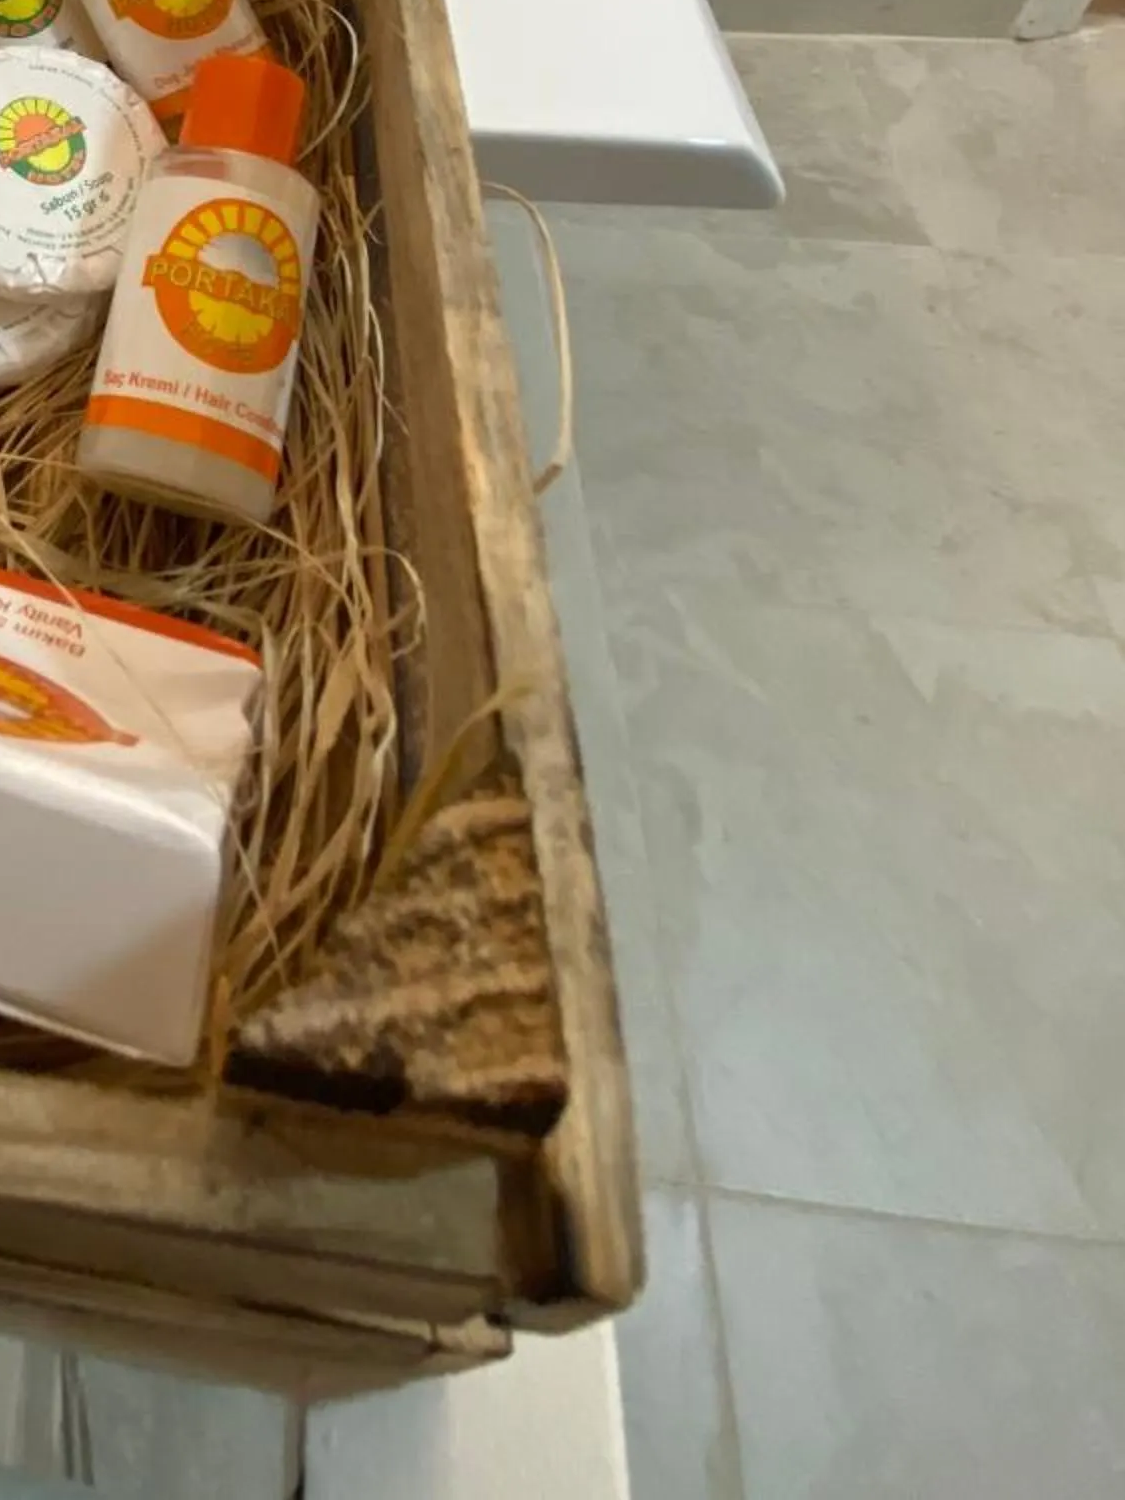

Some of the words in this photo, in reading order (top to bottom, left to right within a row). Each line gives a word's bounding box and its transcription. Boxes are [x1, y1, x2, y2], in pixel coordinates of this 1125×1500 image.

[39, 189, 80, 216] Sabun
[63, 204, 83, 223] 15
[128, 370, 179, 396] Kremi
[194, 384, 233, 413] Hair
[17, 601, 83, 640] Vanity
